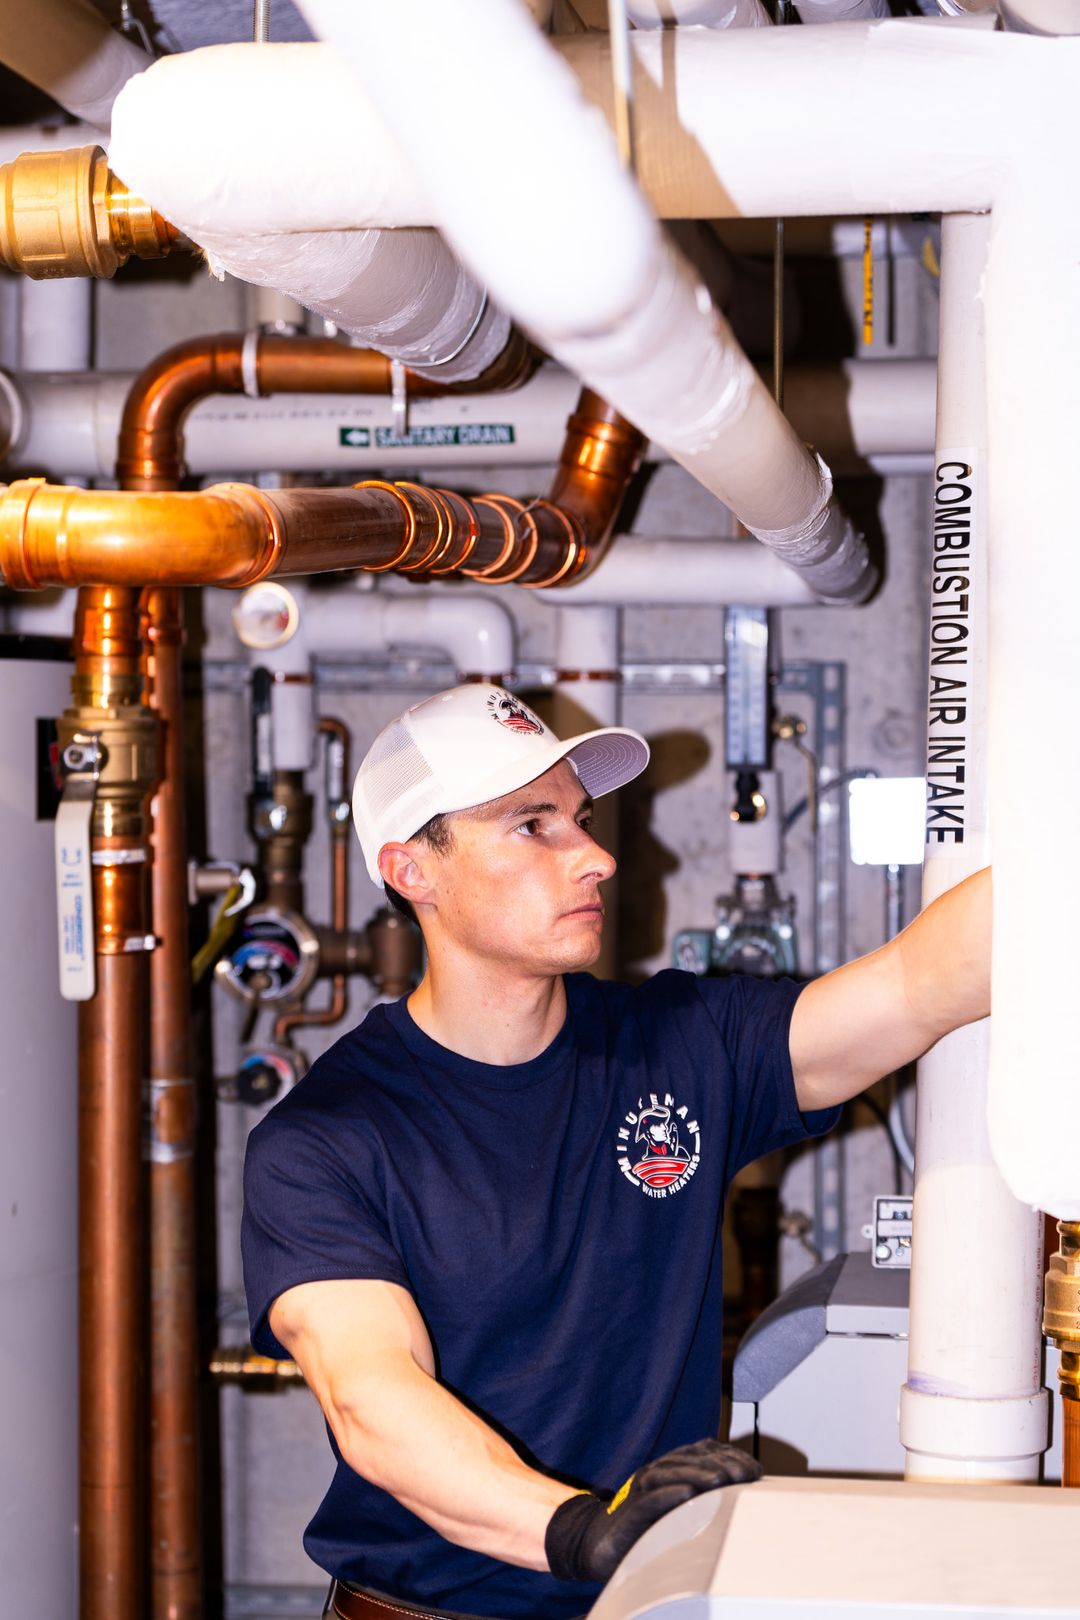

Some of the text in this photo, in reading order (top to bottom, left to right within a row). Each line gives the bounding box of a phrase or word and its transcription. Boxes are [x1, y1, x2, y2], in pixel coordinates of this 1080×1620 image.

[458, 425, 511, 444] DRAIN
[926, 461, 973, 844] COMBUSTION AIR INTAKE
[641, 1154, 700, 1199] WATER HEATERS
